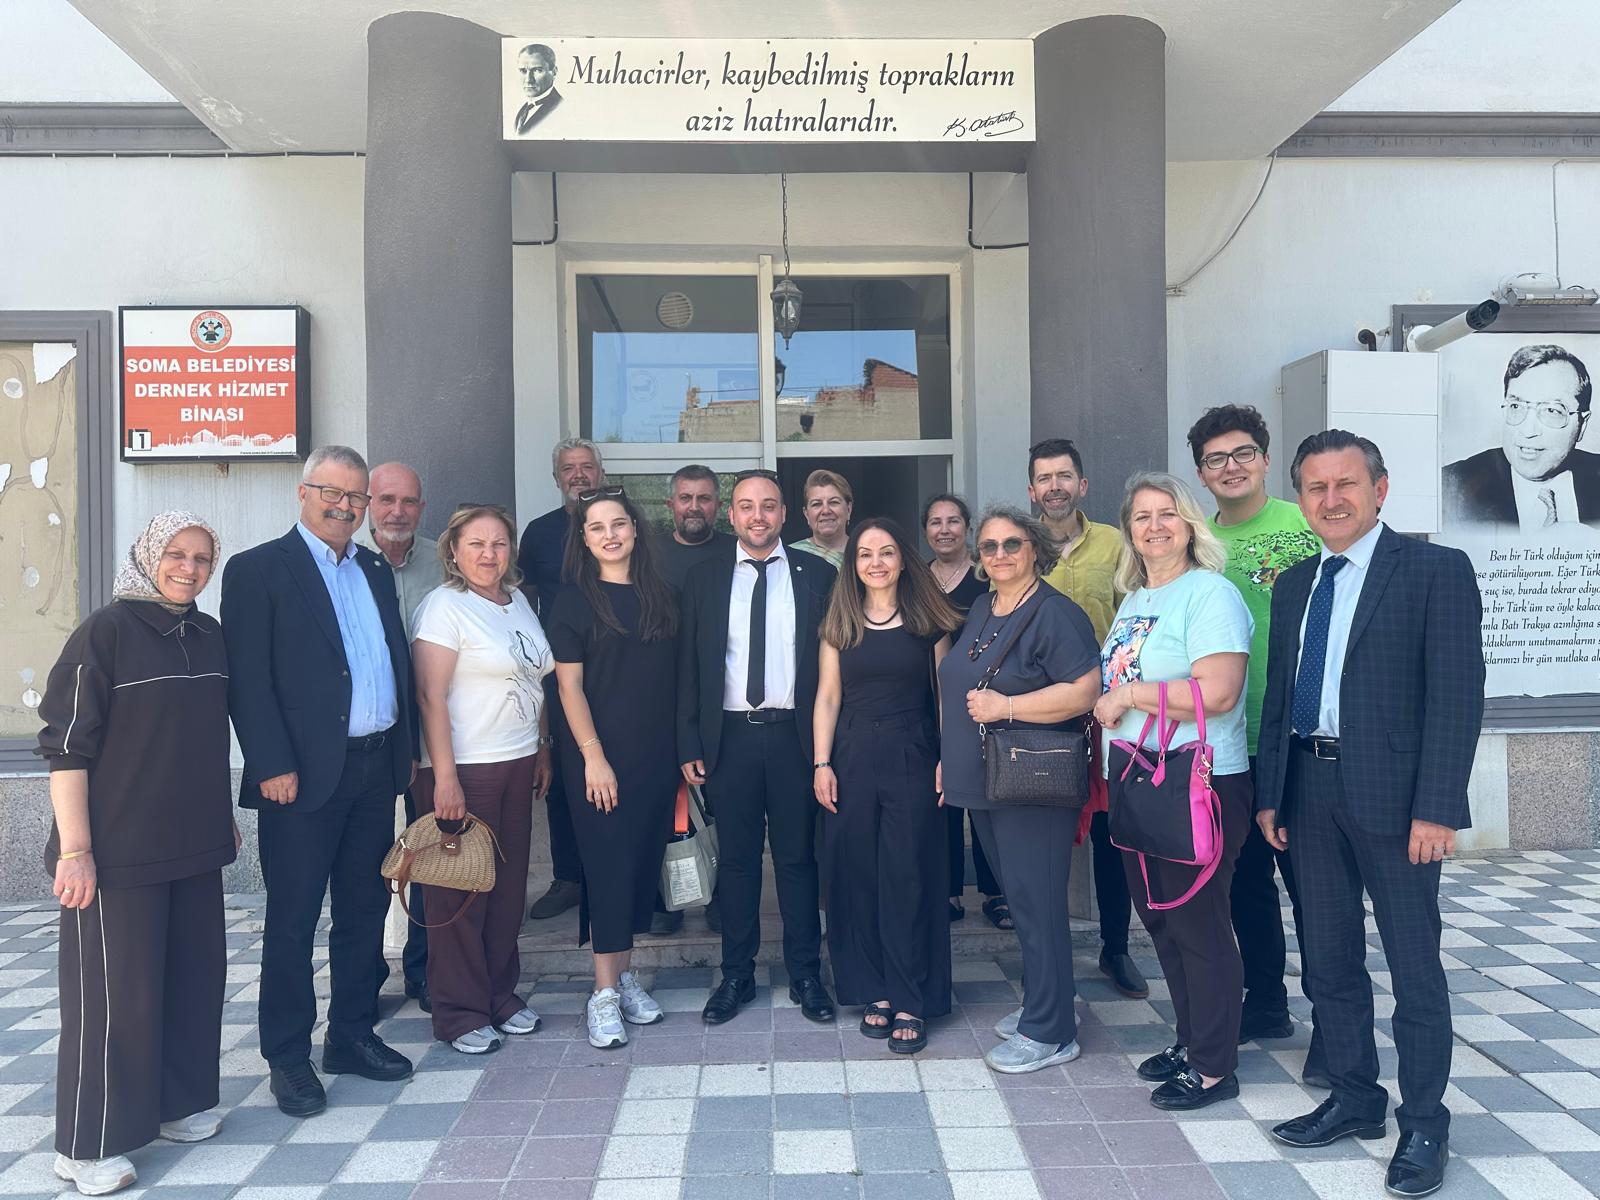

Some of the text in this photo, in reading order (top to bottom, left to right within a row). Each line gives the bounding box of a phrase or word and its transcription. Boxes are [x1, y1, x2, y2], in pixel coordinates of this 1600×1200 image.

[567, 51, 1015, 94] Muhacirler, kaybedilmiş toprakların
[685, 98, 898, 132] aziz hatıralarıdır.
[126, 355, 296, 373] SOMA BELEDİYESİ
[134, 380, 289, 398] DERNEK HİZMET
[180, 405, 244, 422] BİNASI
[138, 433, 145, 450] 1
[1489, 549, 1507, 562] Ben
[1509, 547, 1521, 561] bir
[1523, 547, 1545, 561] Türk
[1546, 546, 1583, 563] olduğum
[1489, 564, 1554, 582] götürülüyorum.
[1557, 565, 1578, 580] Eğer
[1484, 588, 1500, 599] suç
[1501, 585, 1516, 597] ise,
[1517, 581, 1548, 596] burada
[1550, 580, 1577, 595] tekrar
[1492, 599, 1505, 614] bir
[1506, 598, 1543, 613] Türk'üm
[1556, 597, 1575, 615] öyle
[1501, 618, 1519, 630] Batı
[1521, 615, 1551, 633] Trakya
[1552, 615, 1594, 632] azınlığına
[1528, 632, 1596, 647] unutmamalarını
[1484, 650, 1520, 665] klarımızı
[1521, 650, 1535, 664] bir
[1536, 653, 1553, 667] gün
[1554, 648, 1589, 663] mutlaka
